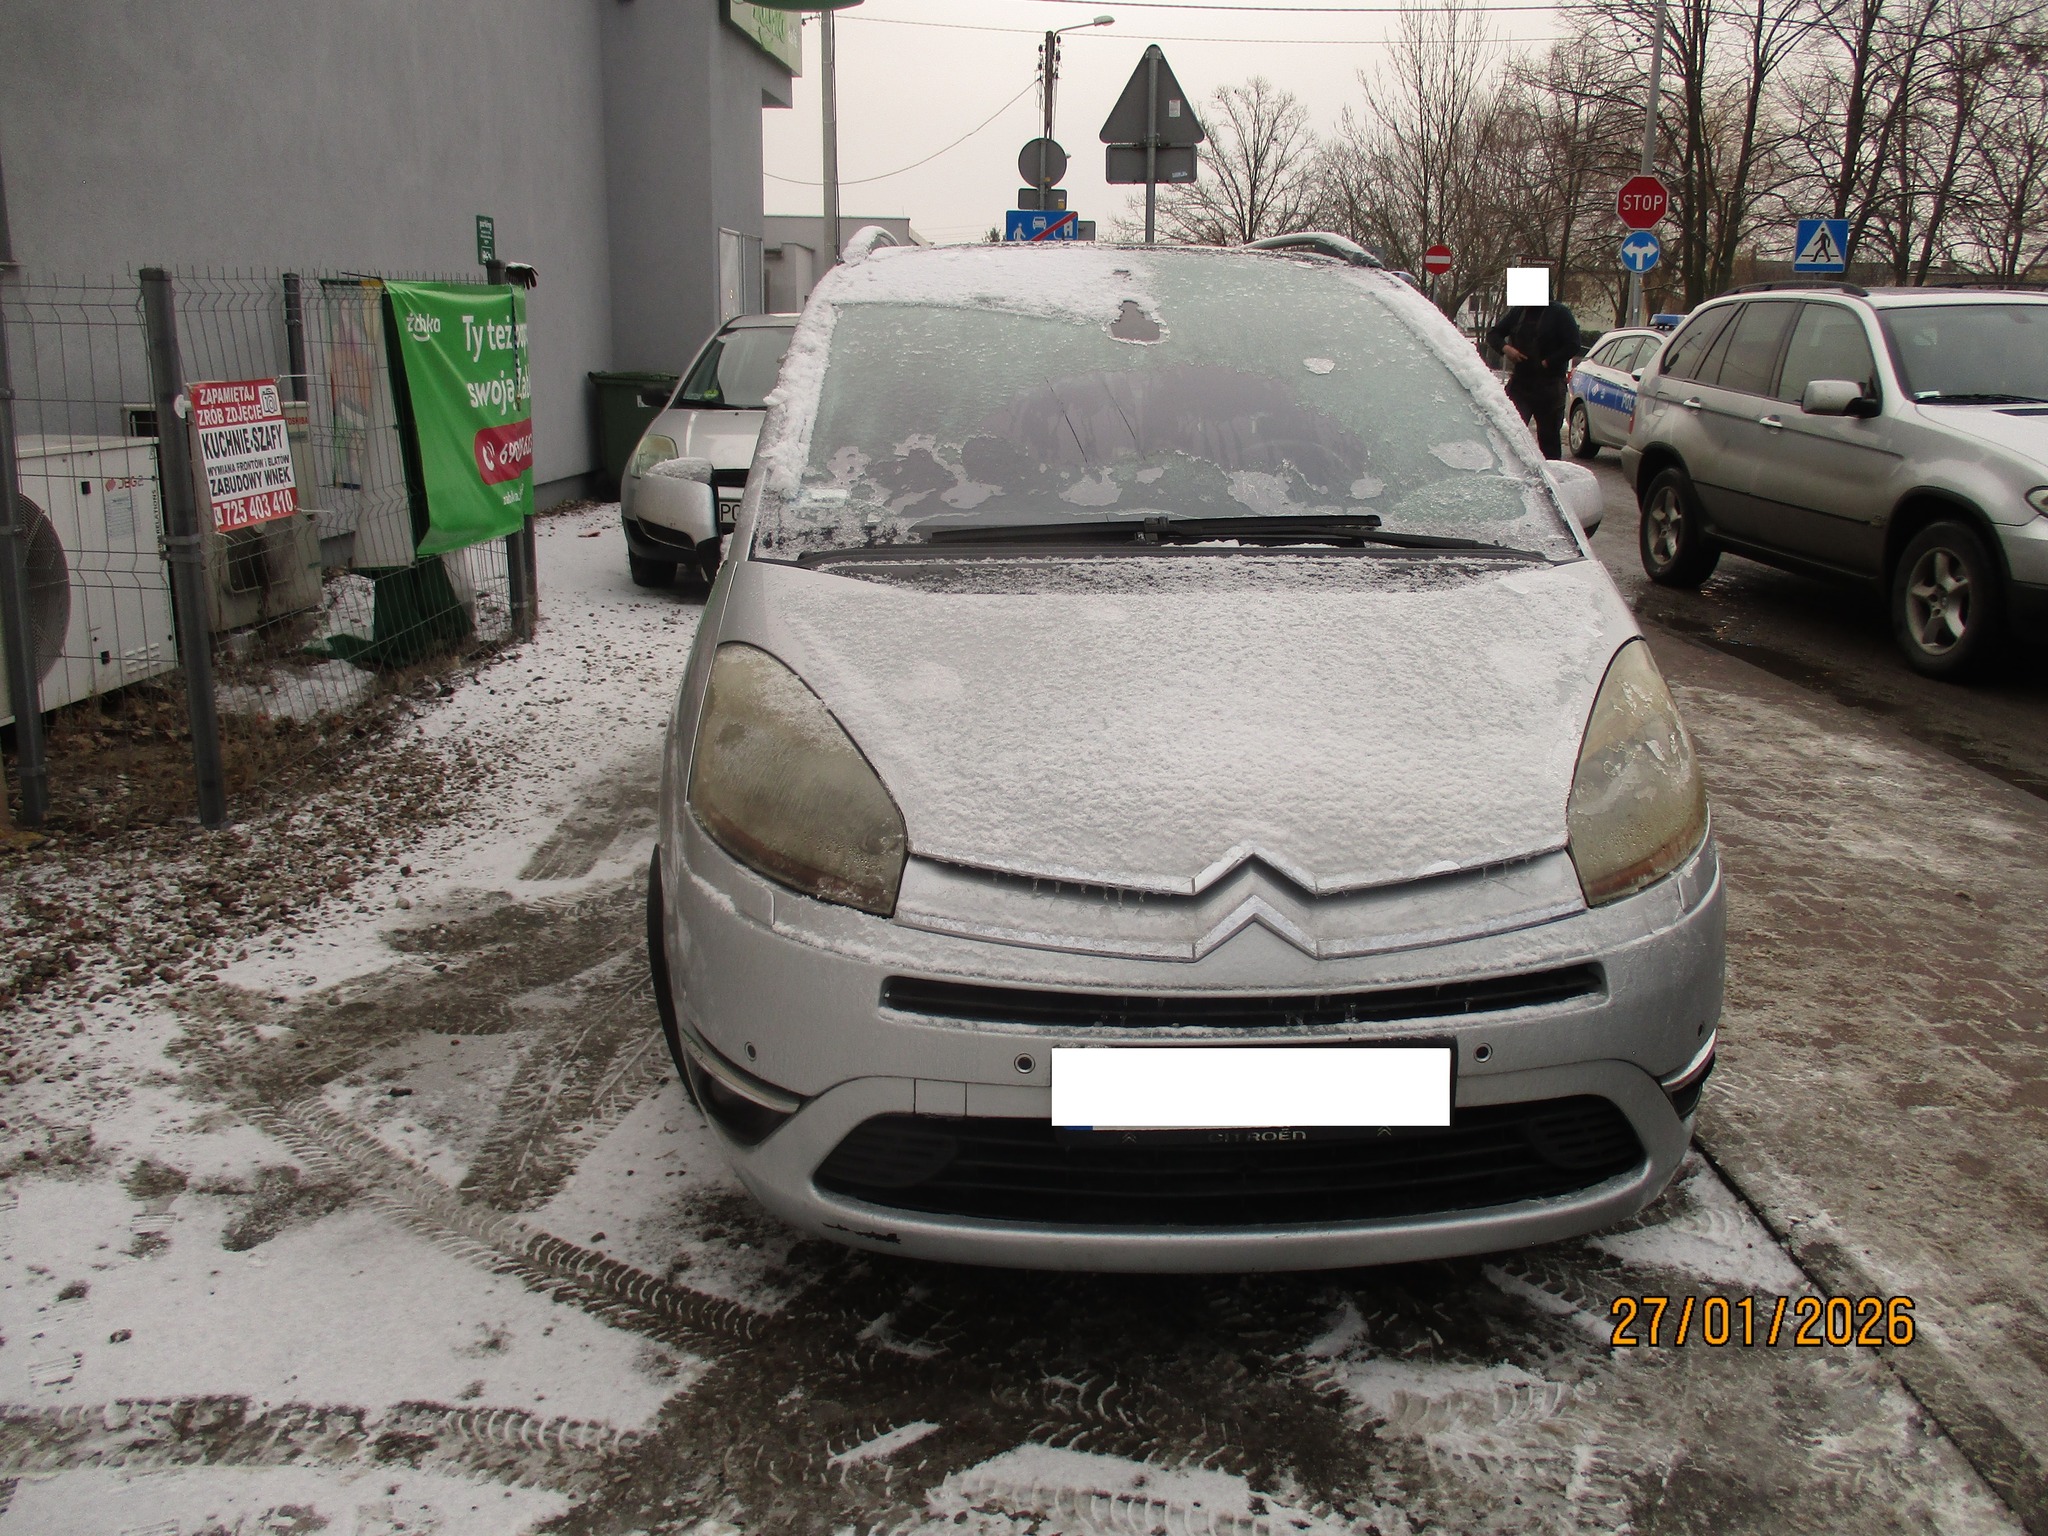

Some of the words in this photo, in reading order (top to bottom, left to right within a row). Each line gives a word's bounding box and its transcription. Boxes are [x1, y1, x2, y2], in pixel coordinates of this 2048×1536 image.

[1622, 194, 1663, 210] STOP
[462, 315, 484, 363] Ty
[487, 315, 513, 351] też
[200, 386, 255, 406] ZAPAMIĘTAJ
[467, 370, 517, 416] swoją
[197, 404, 224, 426] ZRÓB
[226, 404, 263, 424] ZDJĘCIE
[207, 463, 237, 477] WYMIANA
[237, 458, 264, 472] FRONTÓW
[210, 471, 262, 497] ZABUDOWY
[264, 466, 292, 488] WNĘK
[222, 499, 247, 526] 725
[249, 494, 272, 520] 403
[272, 489, 294, 514] 410
